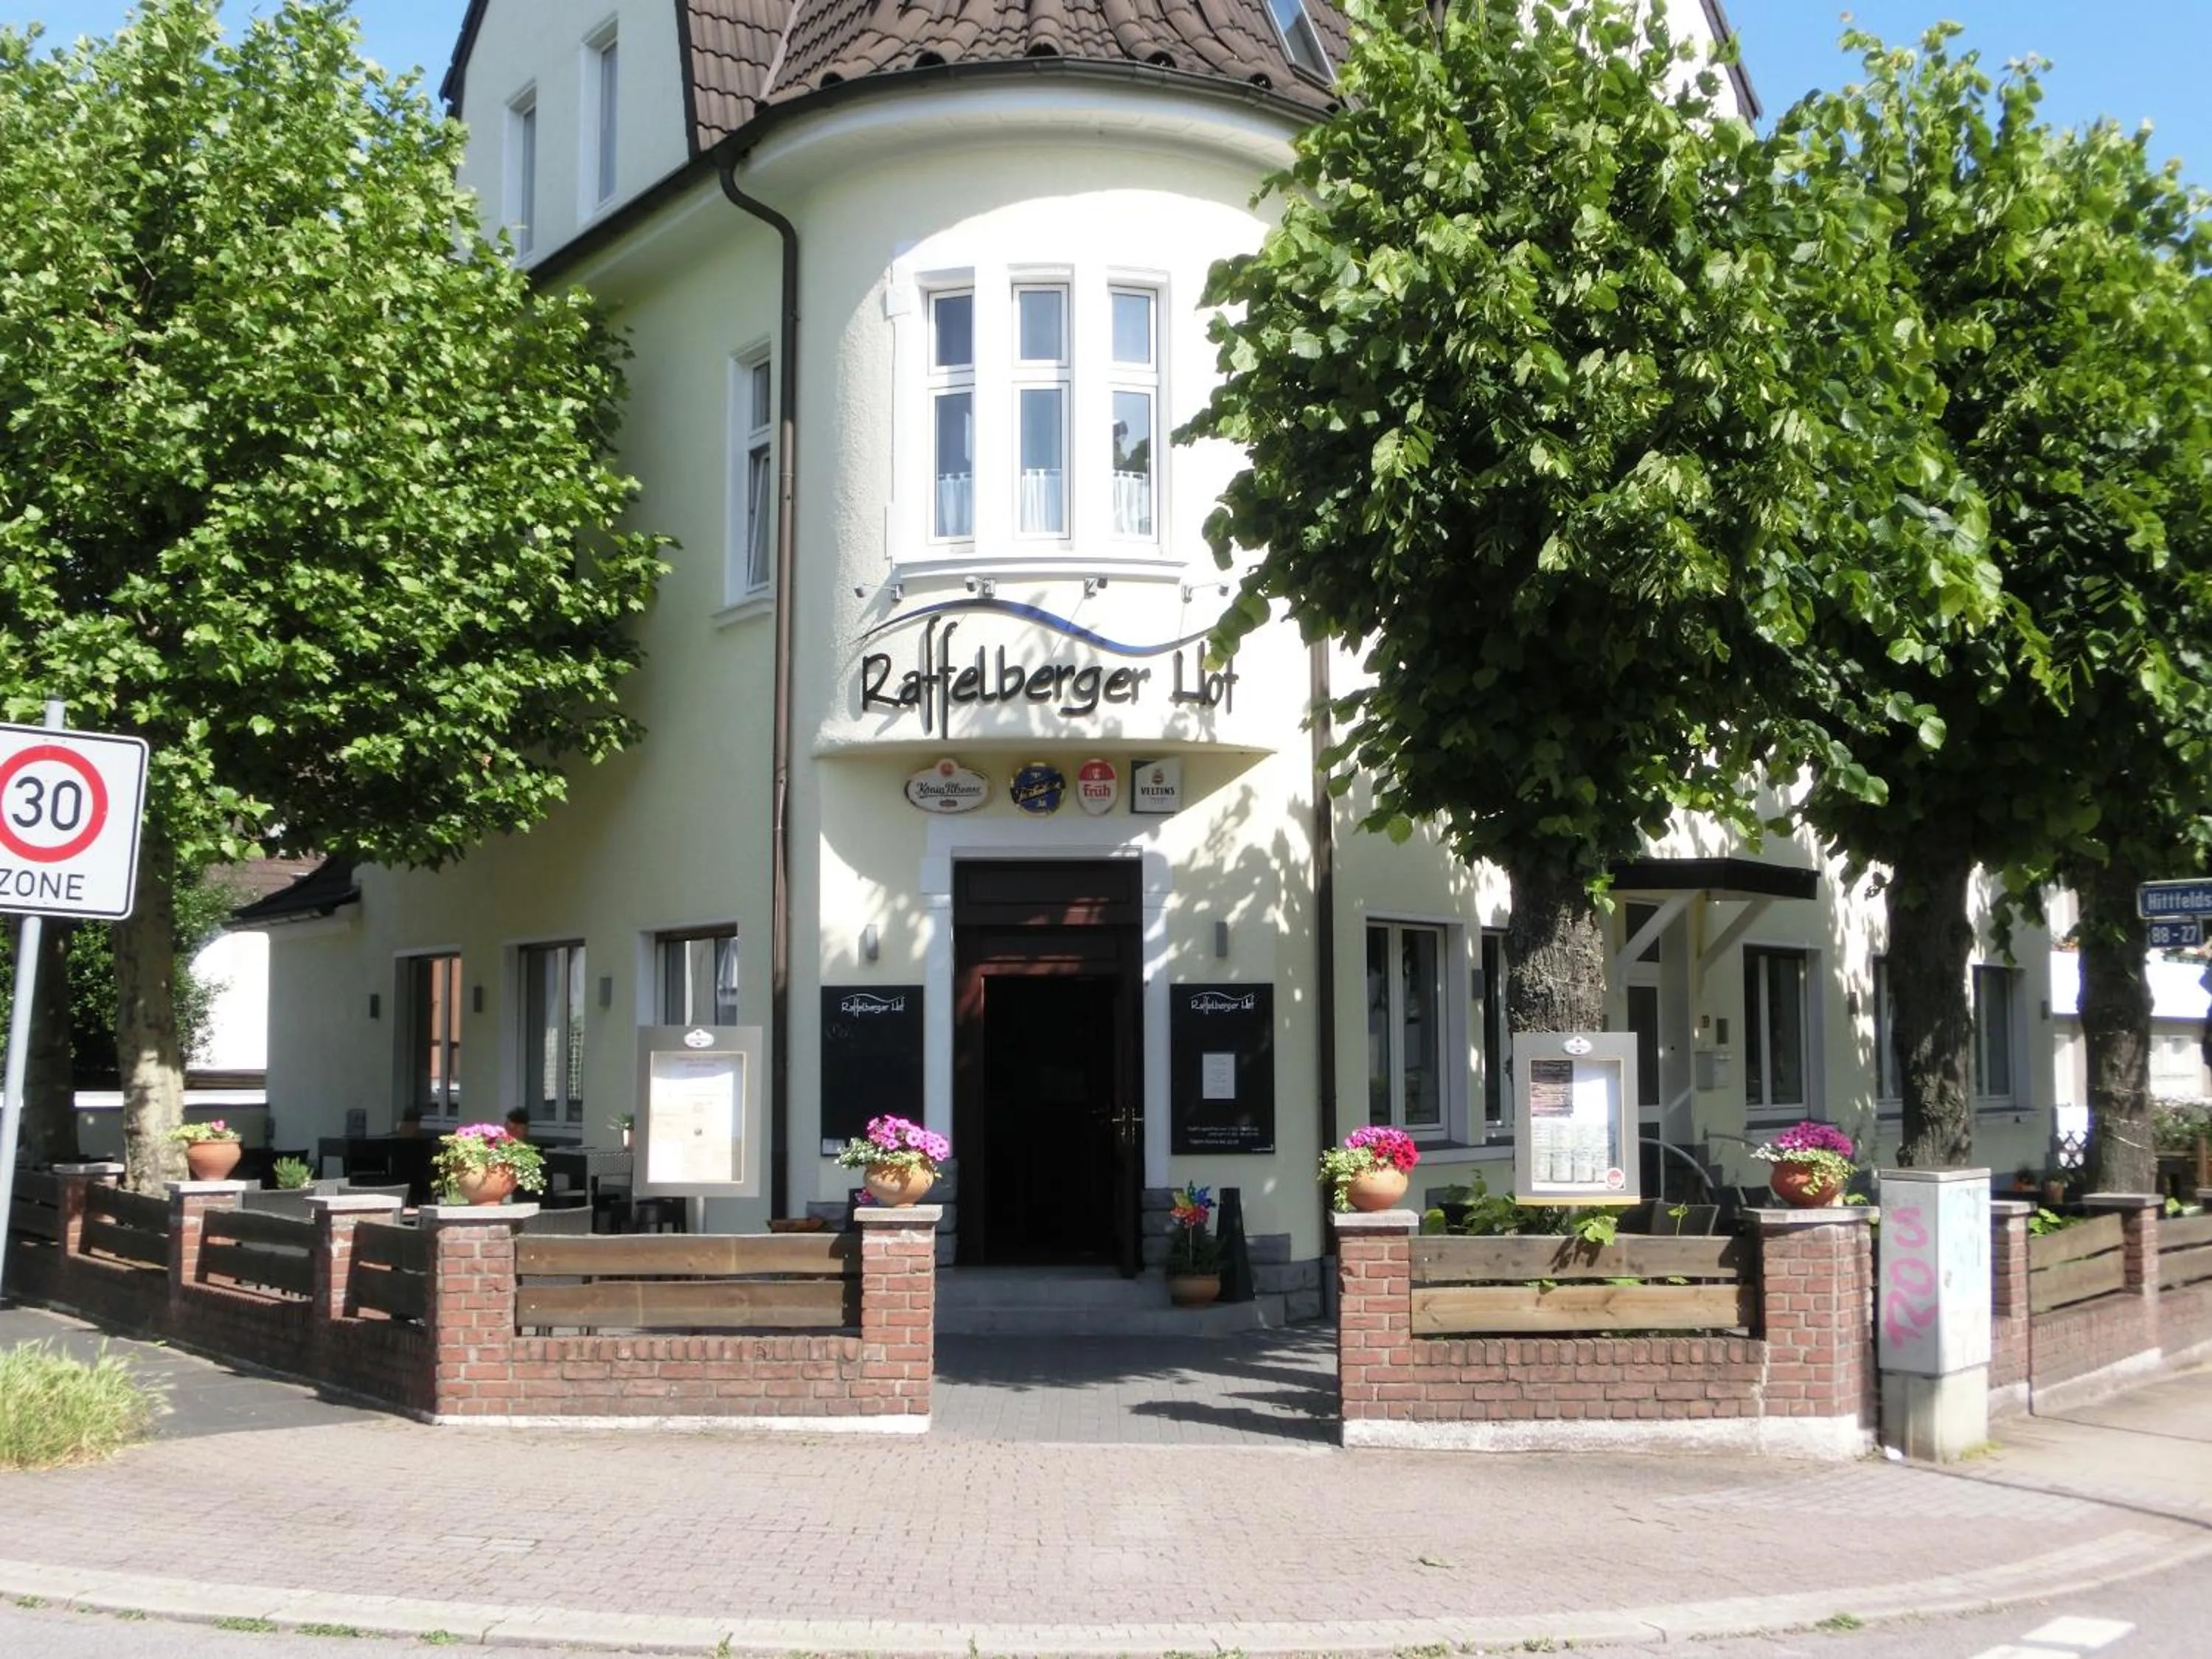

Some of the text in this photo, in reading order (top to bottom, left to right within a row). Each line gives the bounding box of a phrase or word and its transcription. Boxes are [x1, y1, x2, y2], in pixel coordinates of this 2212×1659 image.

[861, 616, 1152, 740] Raffelberger
[12, 776, 83, 831] 30
[1140, 786, 1175, 796] VELTINS
[0, 869, 86, 901] ZONE
[841, 995, 890, 1018] Raffelberger
